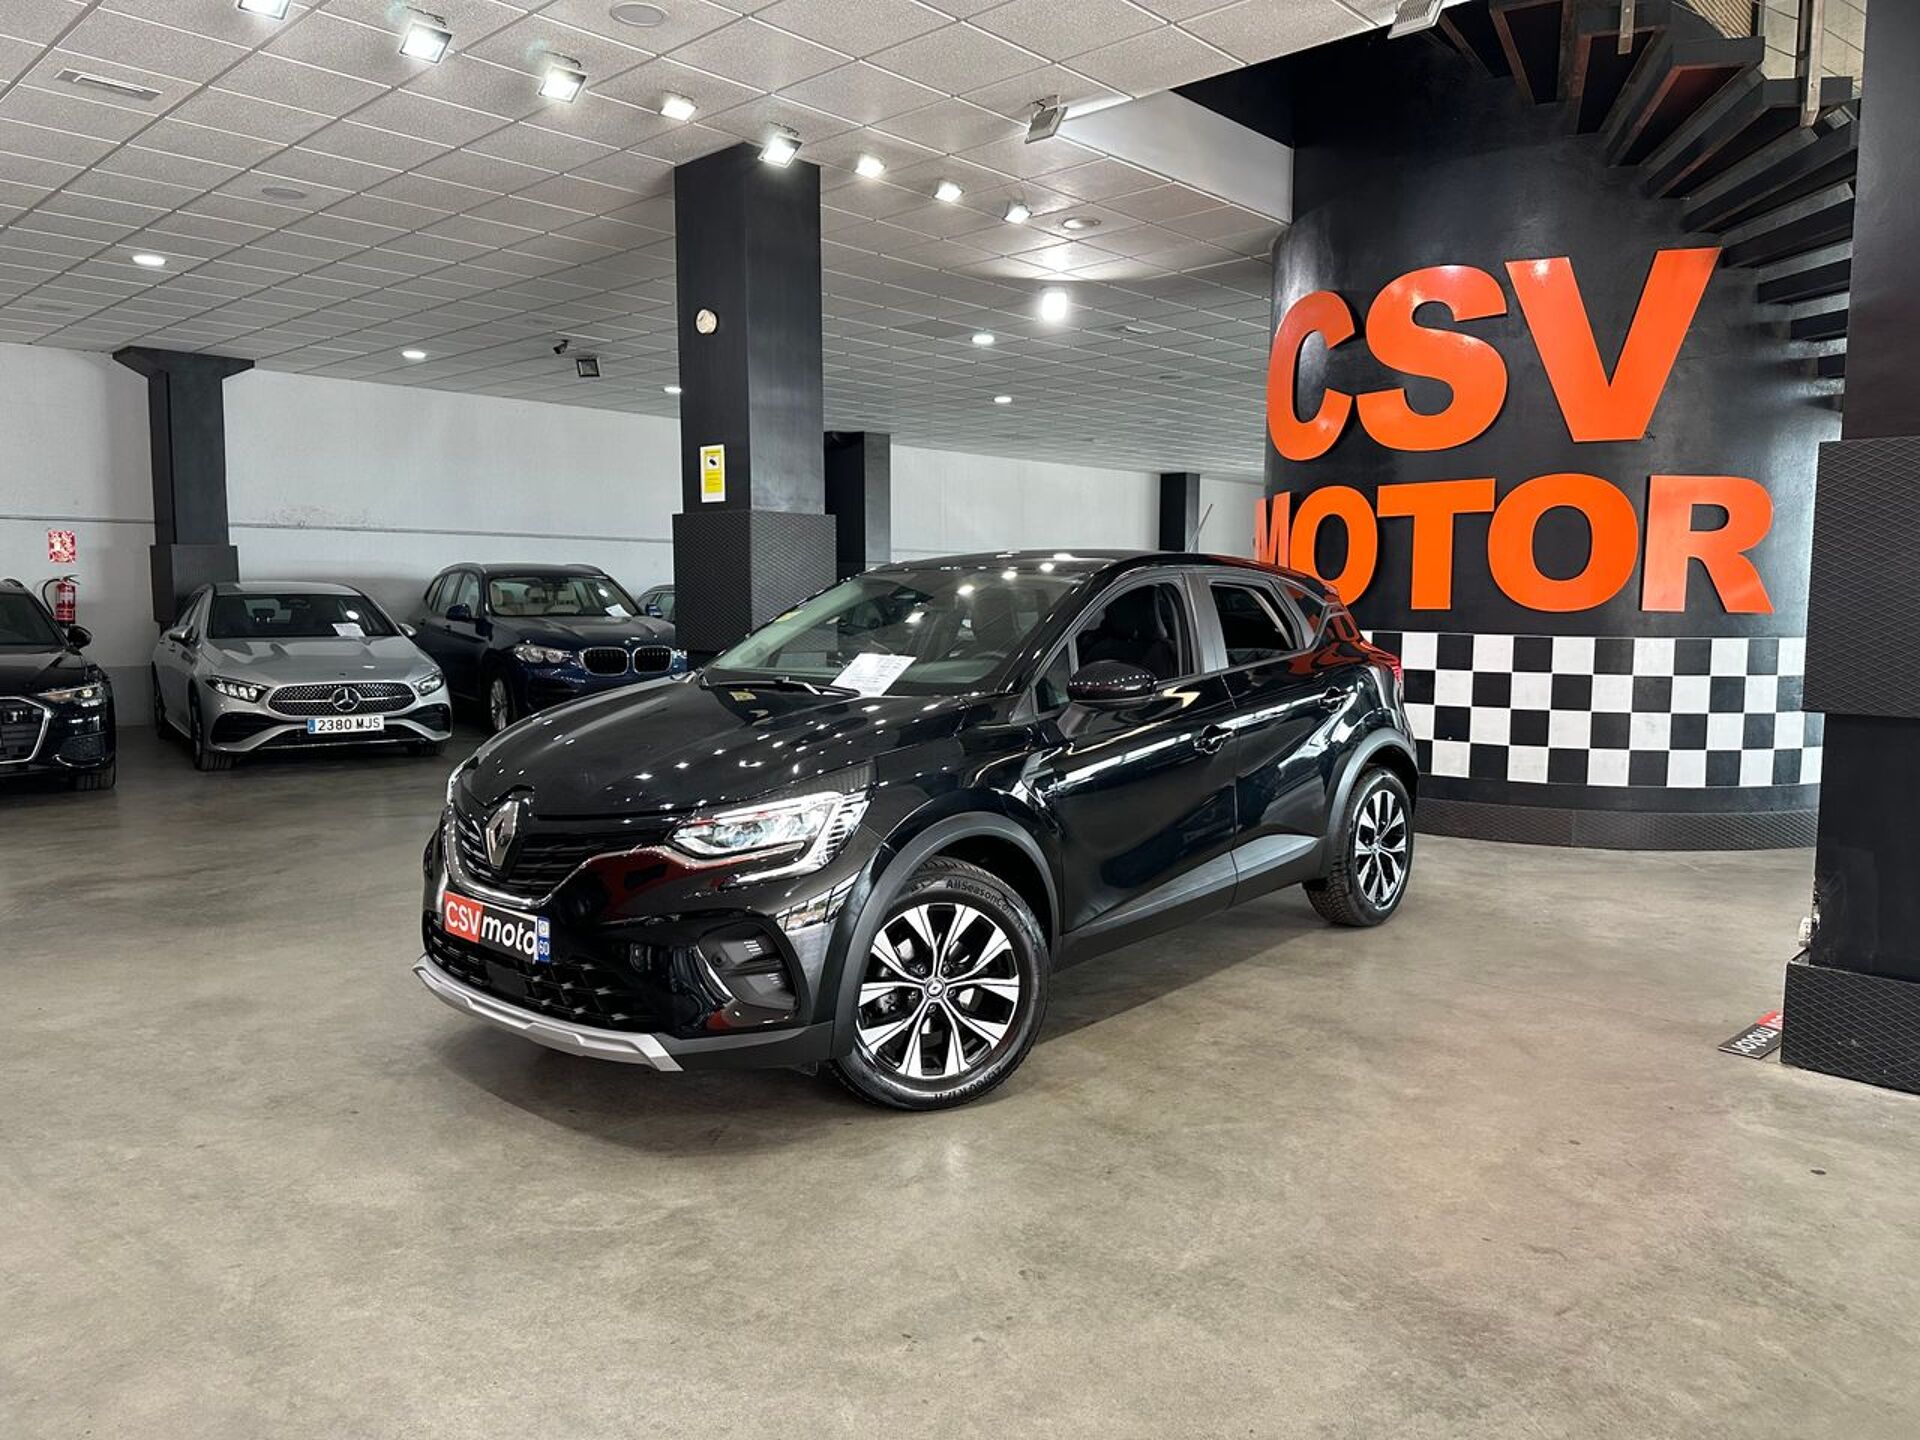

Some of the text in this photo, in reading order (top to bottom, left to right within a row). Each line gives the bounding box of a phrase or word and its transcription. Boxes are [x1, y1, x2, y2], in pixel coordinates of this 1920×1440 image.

[1267, 247, 1721, 461] CSV
[1254, 472, 1774, 613] MOTOR
[318, 719, 352, 731] 2380
